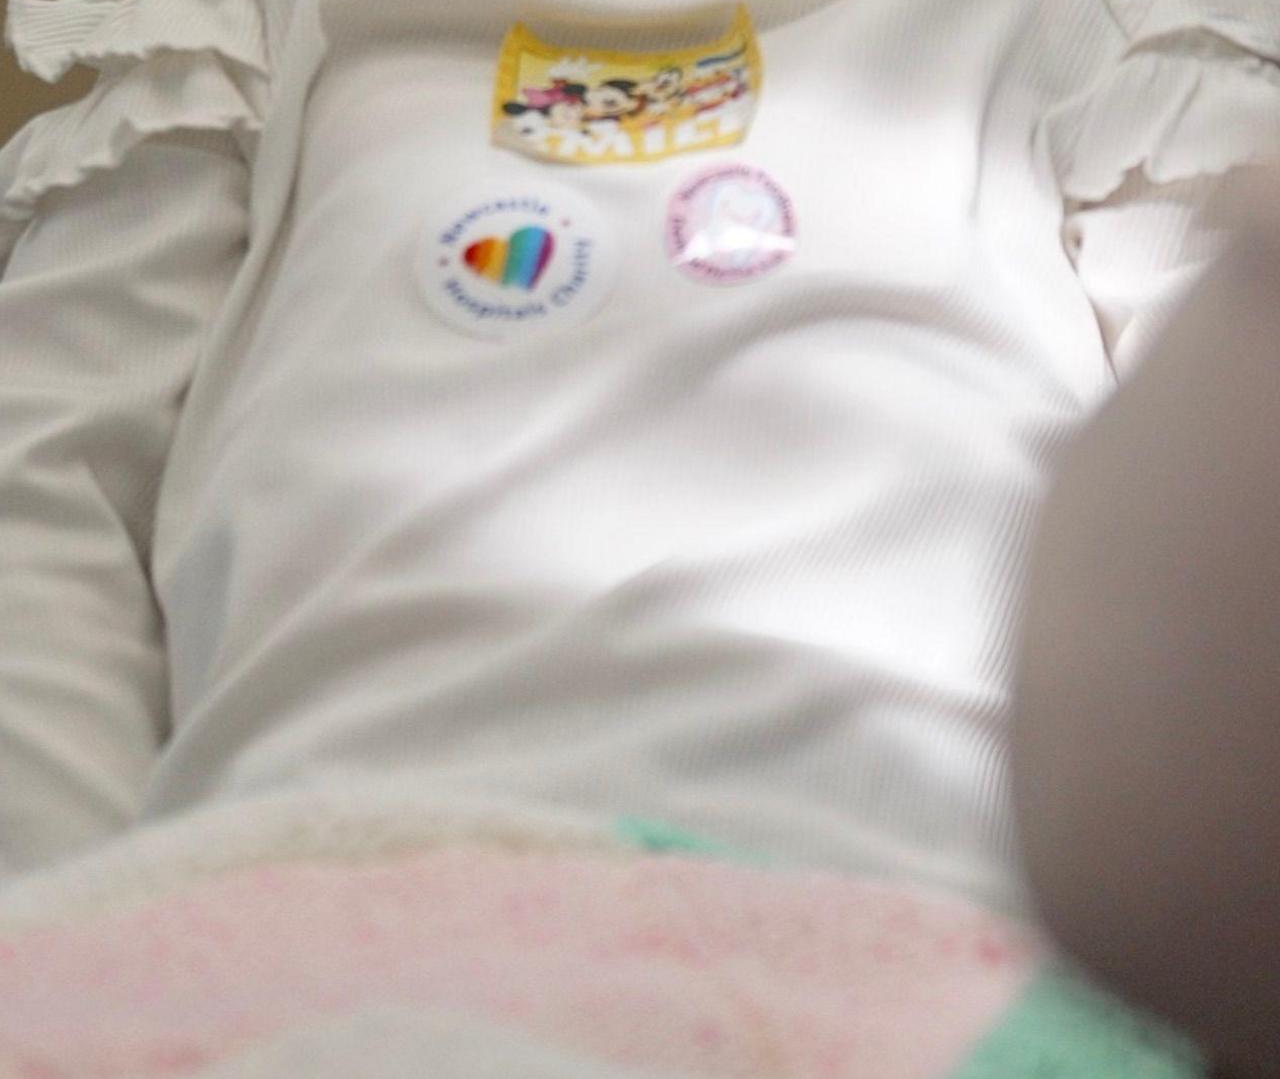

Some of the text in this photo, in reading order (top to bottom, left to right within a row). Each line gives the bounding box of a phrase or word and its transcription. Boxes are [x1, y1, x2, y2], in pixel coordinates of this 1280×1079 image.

[439, 197, 549, 244] Newcastle
[444, 237, 593, 320] Hospitals Charity
